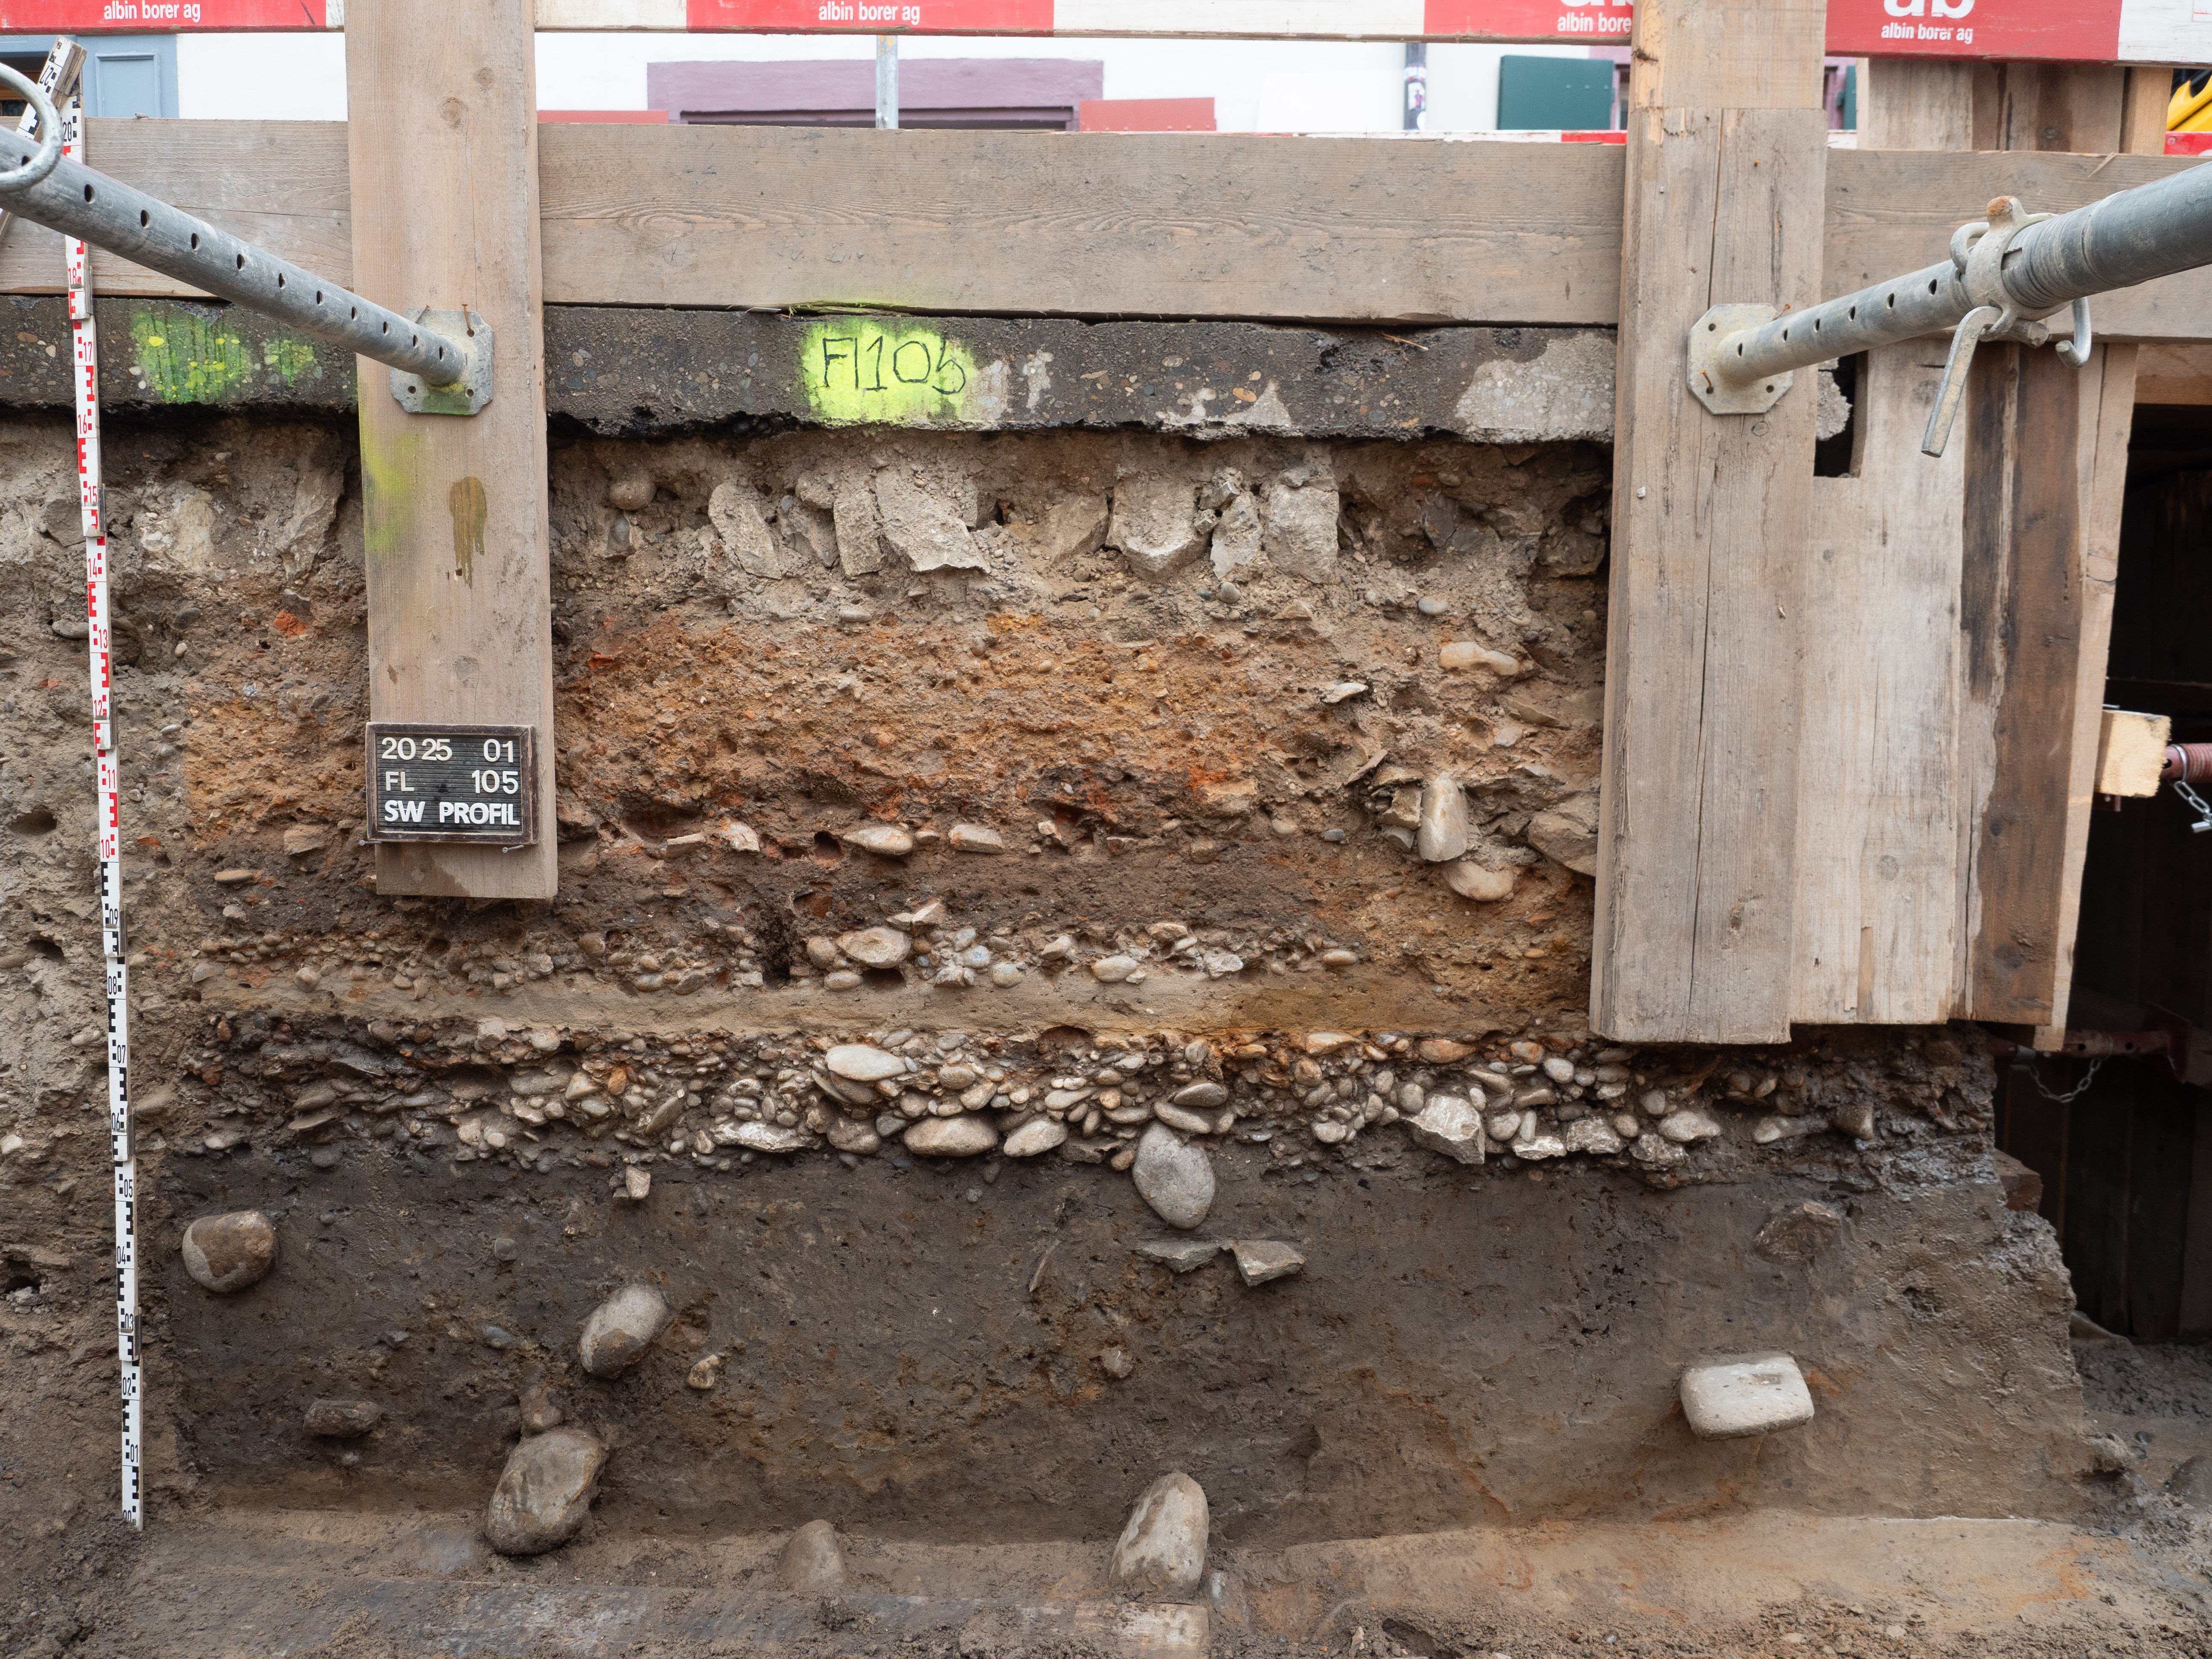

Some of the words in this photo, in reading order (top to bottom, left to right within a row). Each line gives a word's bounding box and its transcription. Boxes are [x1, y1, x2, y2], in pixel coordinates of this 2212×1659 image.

[104, 0, 137, 20] albin
[142, 0, 180, 19] borer
[183, 4, 201, 23] ag
[819, 1, 853, 20] albin
[859, 1, 898, 20] borer
[902, 6, 920, 25] ag
[1557, 12, 1593, 32] albin
[1598, 12, 1632, 33] bore
[1881, 22, 1914, 39] albin
[1918, 23, 1954, 40] borer
[1956, 28, 1973, 44] ag
[68, 267, 77, 285] 18
[84, 341, 92, 361] 17
[78, 414, 87, 434] 16
[88, 486, 97, 503] 15
[88, 558, 97, 578] 14
[99, 629, 108, 649] 13
[94, 699, 102, 716] 12
[483, 739, 514, 763] 01
[108, 769, 115, 789] 11
[386, 771, 415, 792] FL
[472, 769, 519, 795] 105
[384, 800, 425, 822] SW
[439, 802, 520, 825] PROFIL
[101, 839, 110, 859] 10
[109, 908, 118, 925] 09
[108, 976, 117, 995] 08
[117, 1045, 126, 1064] 07
[111, 1112, 120, 1131] 06
[124, 1179, 133, 1198] 05
[117, 1246, 126, 1265] 04
[125, 1313, 134, 1329] 03
[122, 1377, 131, 1396] 02
[130, 1444, 138, 1463] 01
